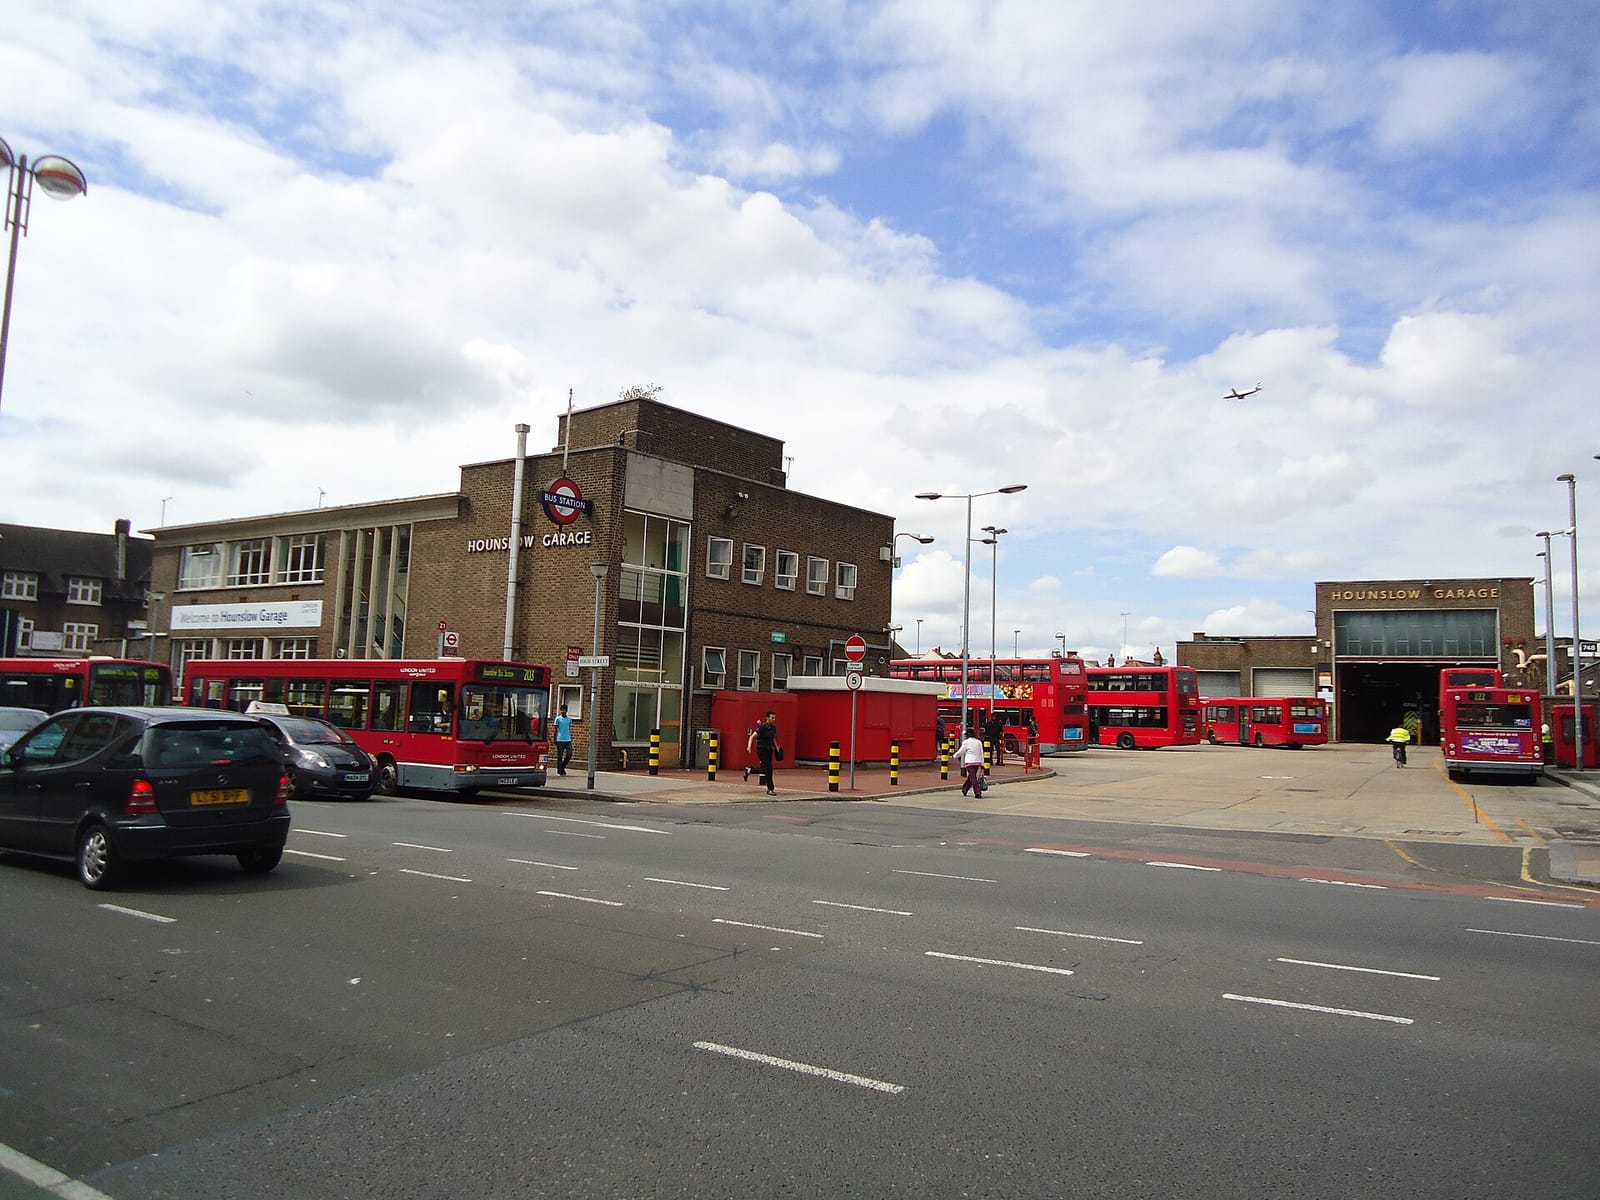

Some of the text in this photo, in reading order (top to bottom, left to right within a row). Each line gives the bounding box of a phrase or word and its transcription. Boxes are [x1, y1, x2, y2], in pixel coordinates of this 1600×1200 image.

[544, 493, 586, 509] BUS STATION
[542, 530, 592, 547] GARAGE
[1331, 588, 1499, 600] HOUNSLOW GARAGE
[179, 608, 288, 624] Welcome to Hounslow Garage
[523, 669, 535, 681] 203
[851, 676, 857, 685] 5
